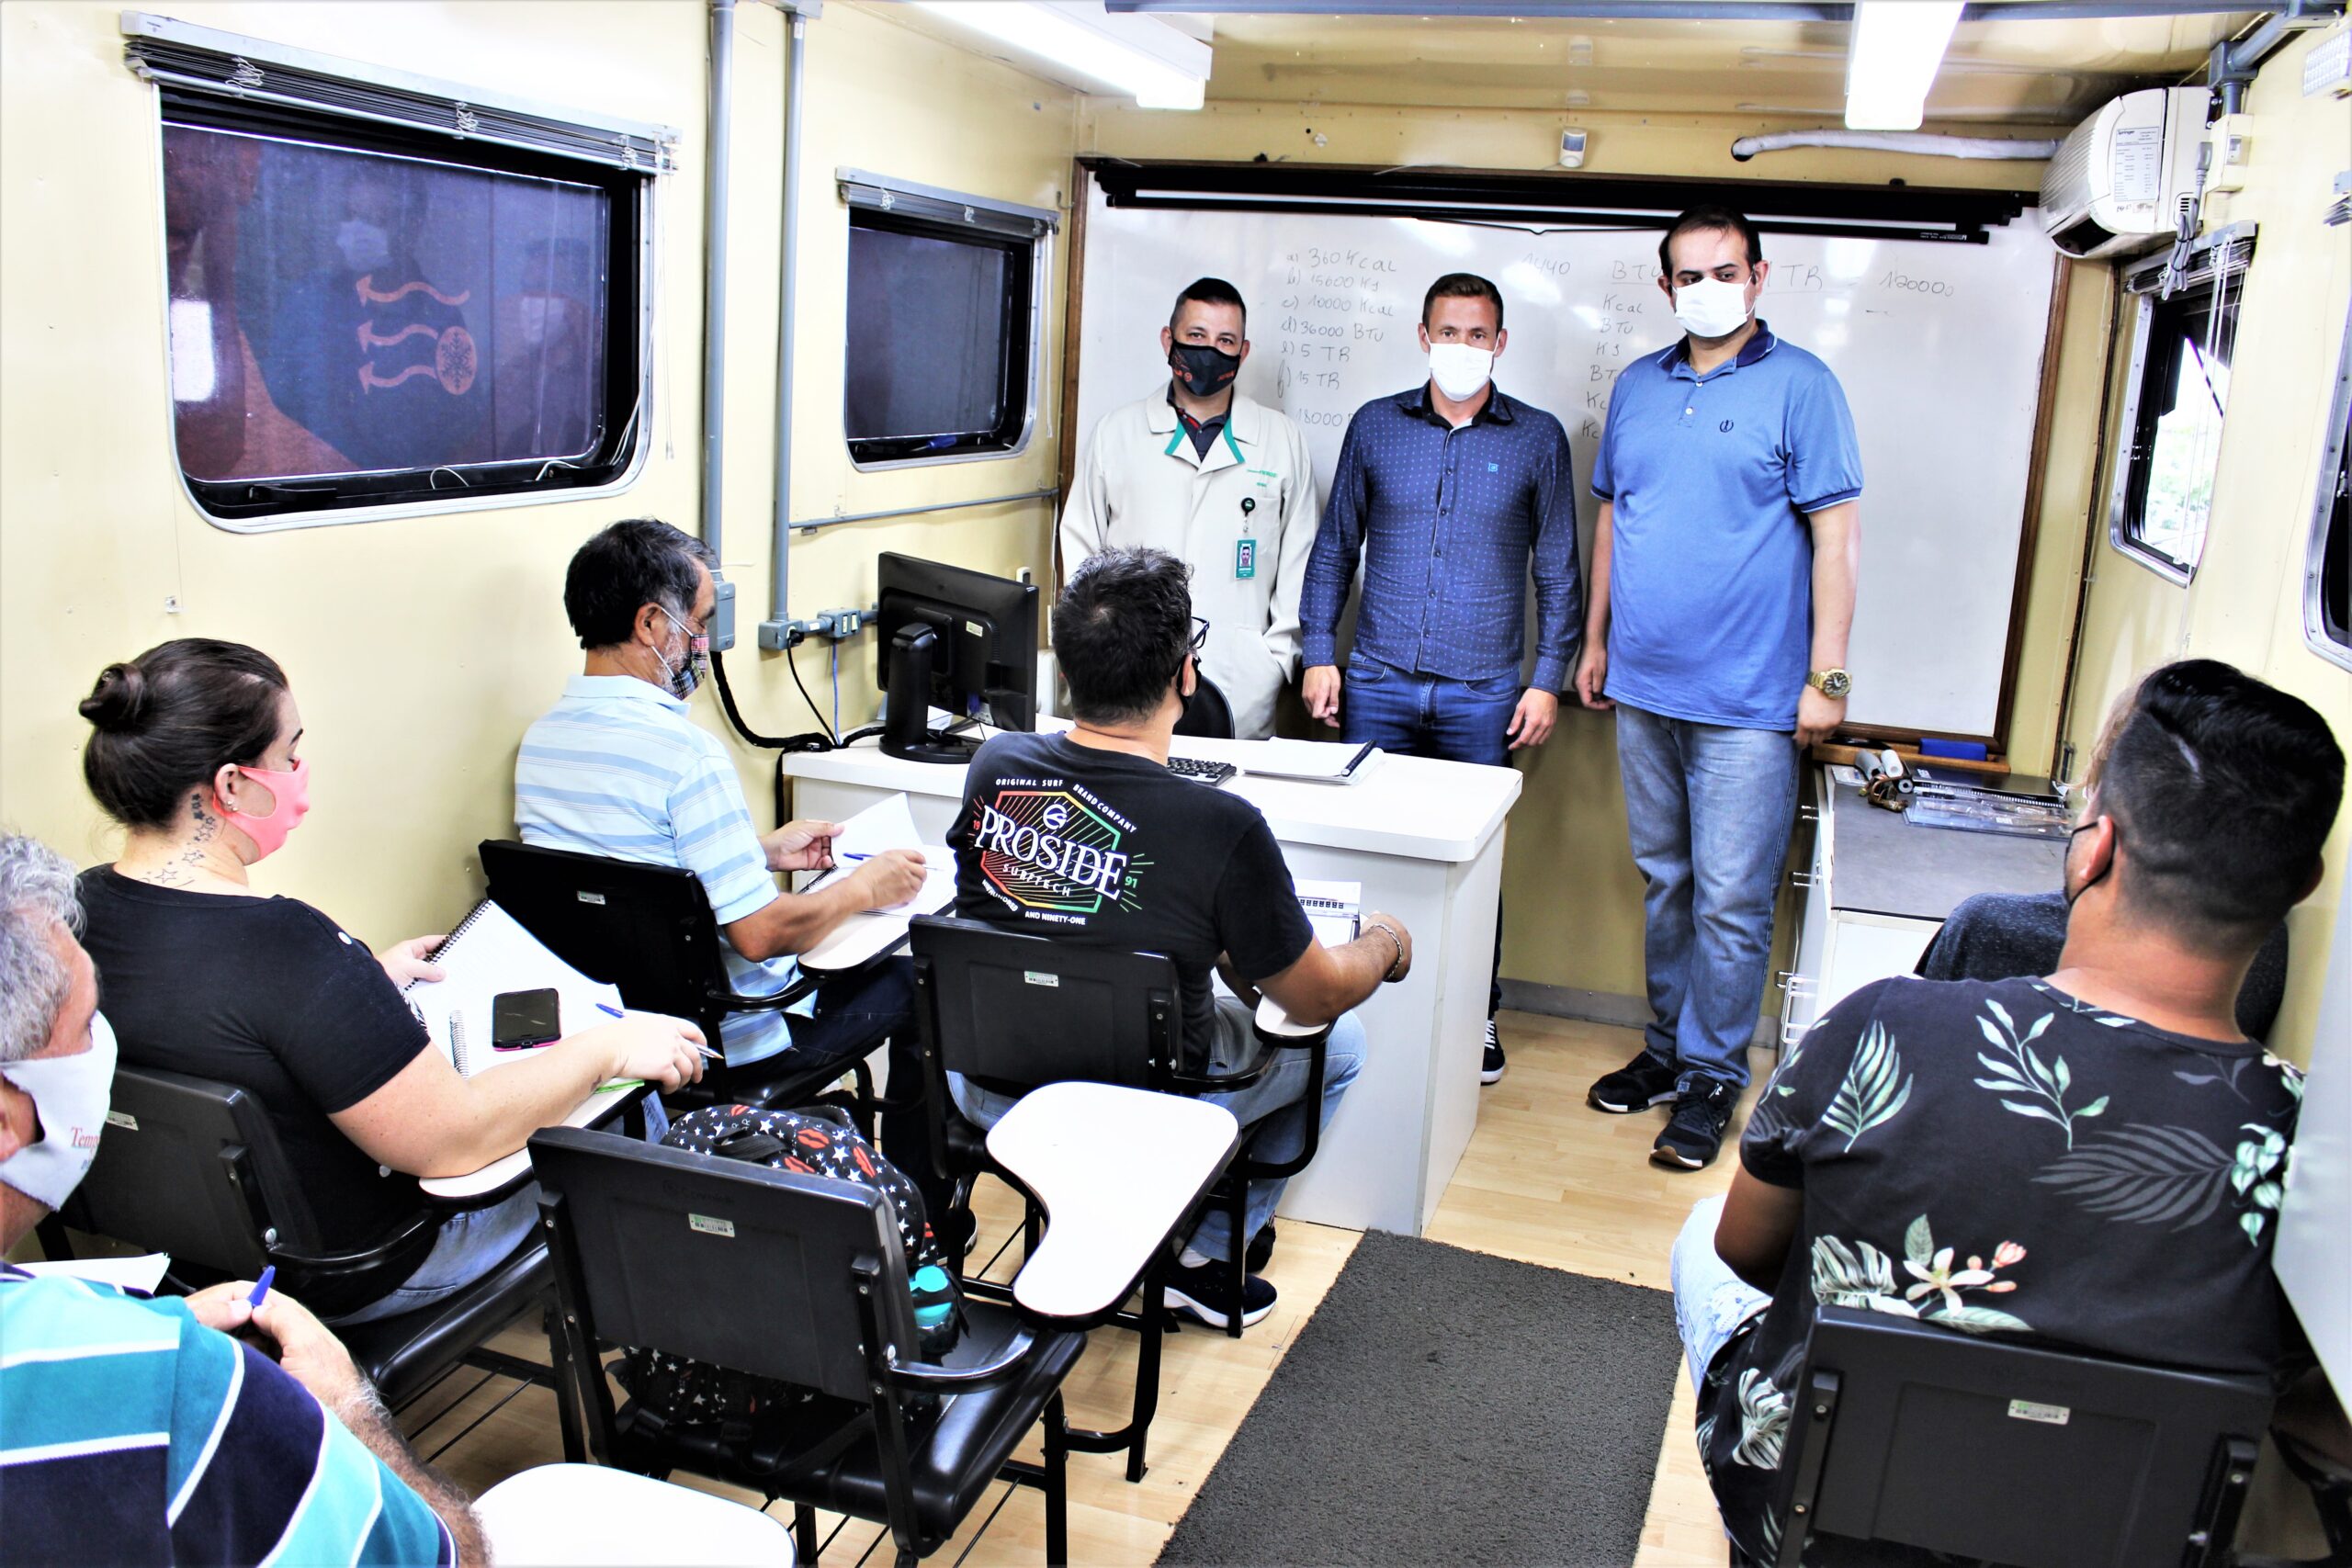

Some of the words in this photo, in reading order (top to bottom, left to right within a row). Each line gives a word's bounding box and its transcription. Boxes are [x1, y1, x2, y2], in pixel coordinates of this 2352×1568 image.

[1308, 247, 1341, 268] 360
[1308, 294, 1352, 312] 10000
[1602, 293, 1644, 314] Kcal
[1300, 320, 1344, 338] 36000
[1300, 343, 1312, 358] 5
[1320, 345, 1351, 363] TR
[1298, 370, 1310, 385] 15
[1316, 371, 1340, 391] TR
[995, 778, 1037, 786] ORIGINAL
[1042, 779, 1064, 787] SURF
[1072, 784, 1099, 806] BRAND
[1096, 802, 1137, 833] COMPANY
[973, 819, 981, 830] 19
[974, 804, 1127, 901] PROSIDE
[1002, 863, 1071, 897] SURFTECH
[1125, 875, 1138, 889] 91
[1024, 910, 1041, 919] AND
[1041, 913, 1086, 926] NINETY-ONE
